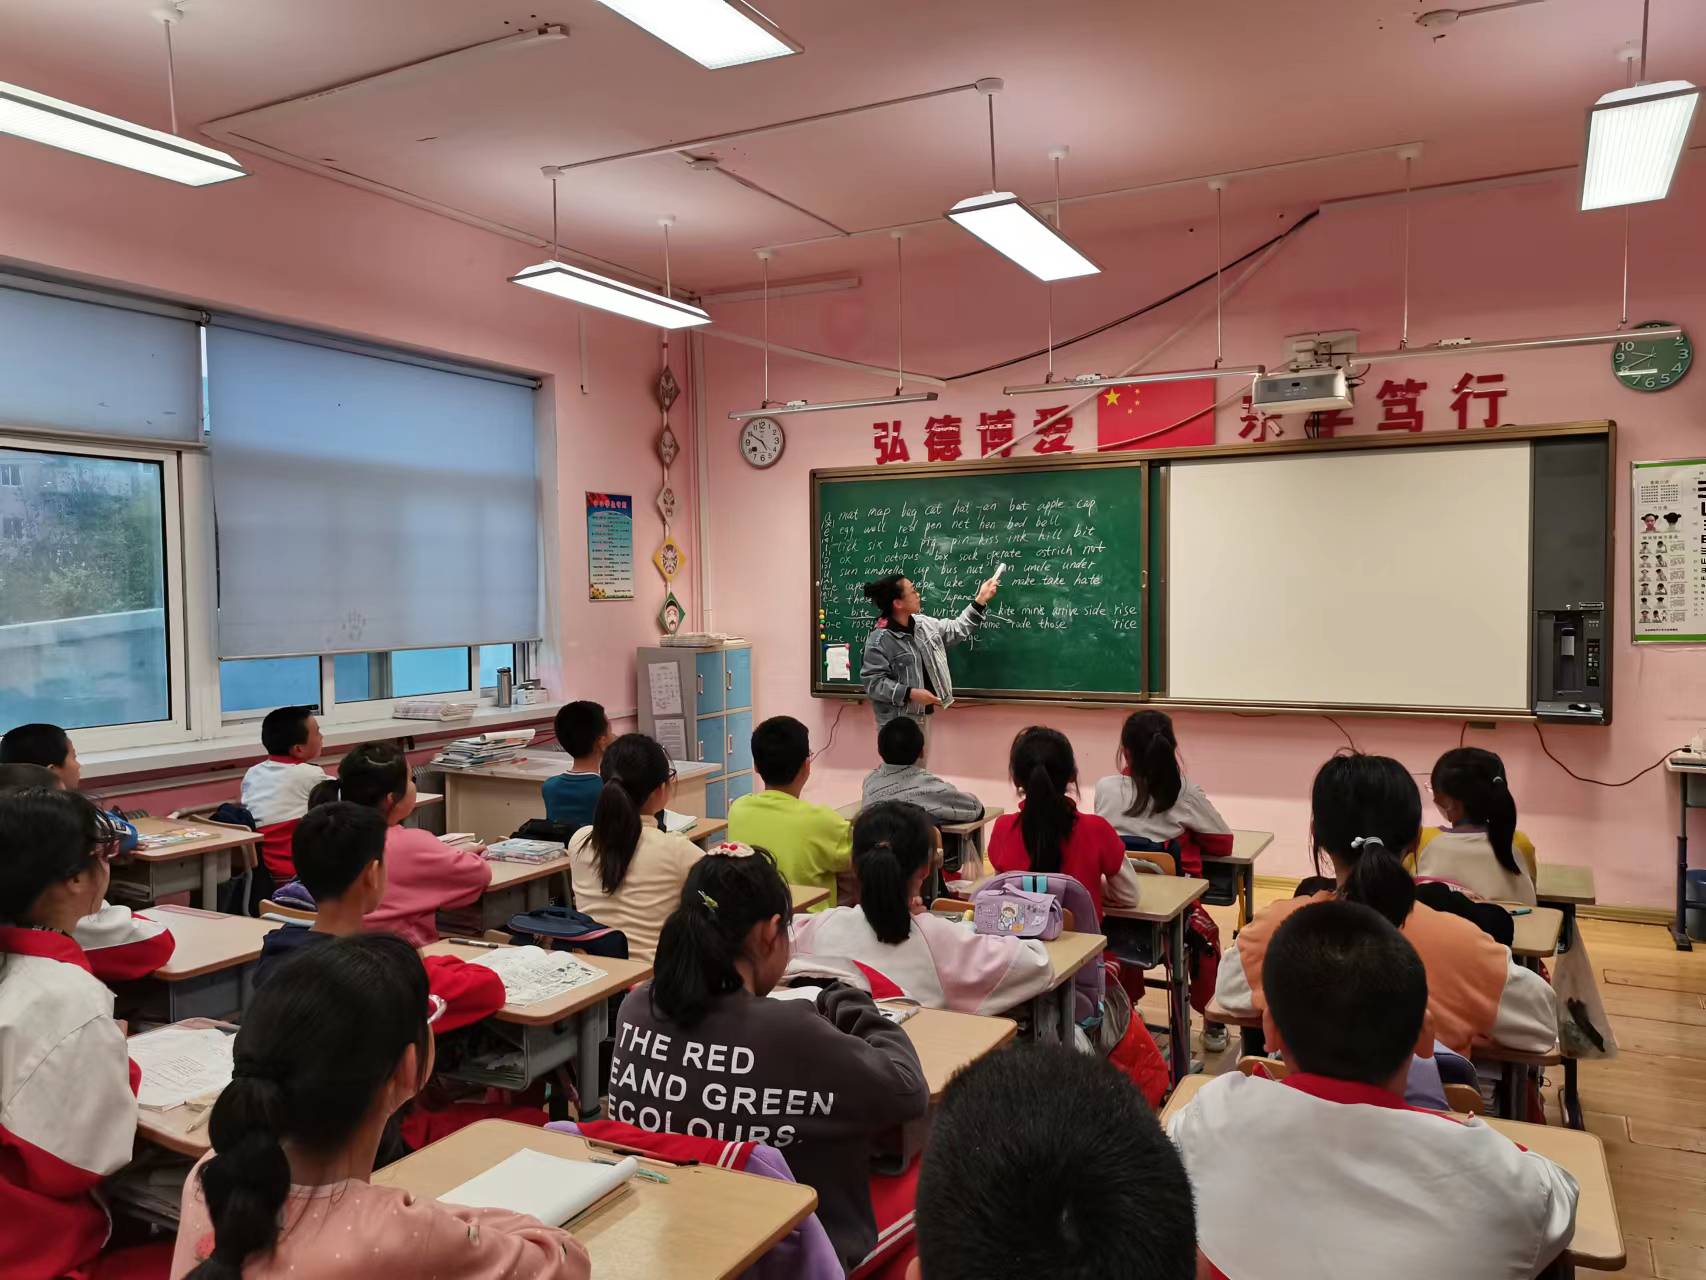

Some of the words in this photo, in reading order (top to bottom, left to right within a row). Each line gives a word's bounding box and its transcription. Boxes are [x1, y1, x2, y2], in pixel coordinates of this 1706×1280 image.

[1621, 341, 1635, 351] 10
[1678, 348, 1689, 359] 3
[1615, 352, 1625, 363] 9
[1671, 362, 1682, 373] 4
[1632, 374, 1641, 385] 7
[1645, 377, 1655, 388] 6
[1660, 373, 1670, 383] 5
[868, 507, 891, 524] map
[924, 503, 943, 516] cat
[1009, 498, 1029, 511] bat
[1037, 497, 1064, 516] apple
[1077, 499, 1096, 517] cap
[840, 526, 855, 542] egg
[922, 521, 942, 539] pen
[951, 520, 970, 530] net
[867, 540, 883, 551] six
[919, 536, 936, 556] pig
[978, 532, 999, 546] kiss
[1038, 528, 1063, 542] hill
[1073, 523, 1095, 538] bit
[840, 555, 852, 564] ox
[863, 554, 876, 563] on
[884, 551, 919, 568] octopus
[935, 550, 949, 561] box
[1036, 543, 1073, 558] ostrich
[840, 567, 858, 577] sun
[864, 564, 904, 576] umbrella
[940, 560, 957, 575] bus
[966, 564, 983, 574] nut
[1023, 560, 1051, 572] uncle
[1062, 557, 1096, 570] under
[944, 575, 965, 588] lake
[1012, 573, 1037, 586] make
[1042, 572, 1066, 586] take
[851, 604, 870, 617] bite
[998, 600, 1015, 616] kite
[1084, 602, 1107, 616] side
[1113, 601, 1137, 617] rise
[1039, 616, 1067, 629] those
[1112, 618, 1137, 630] rice
[618, 1022, 672, 1061] THE
[682, 1041, 755, 1075] RED
[702, 1083, 834, 1116] GREEN
